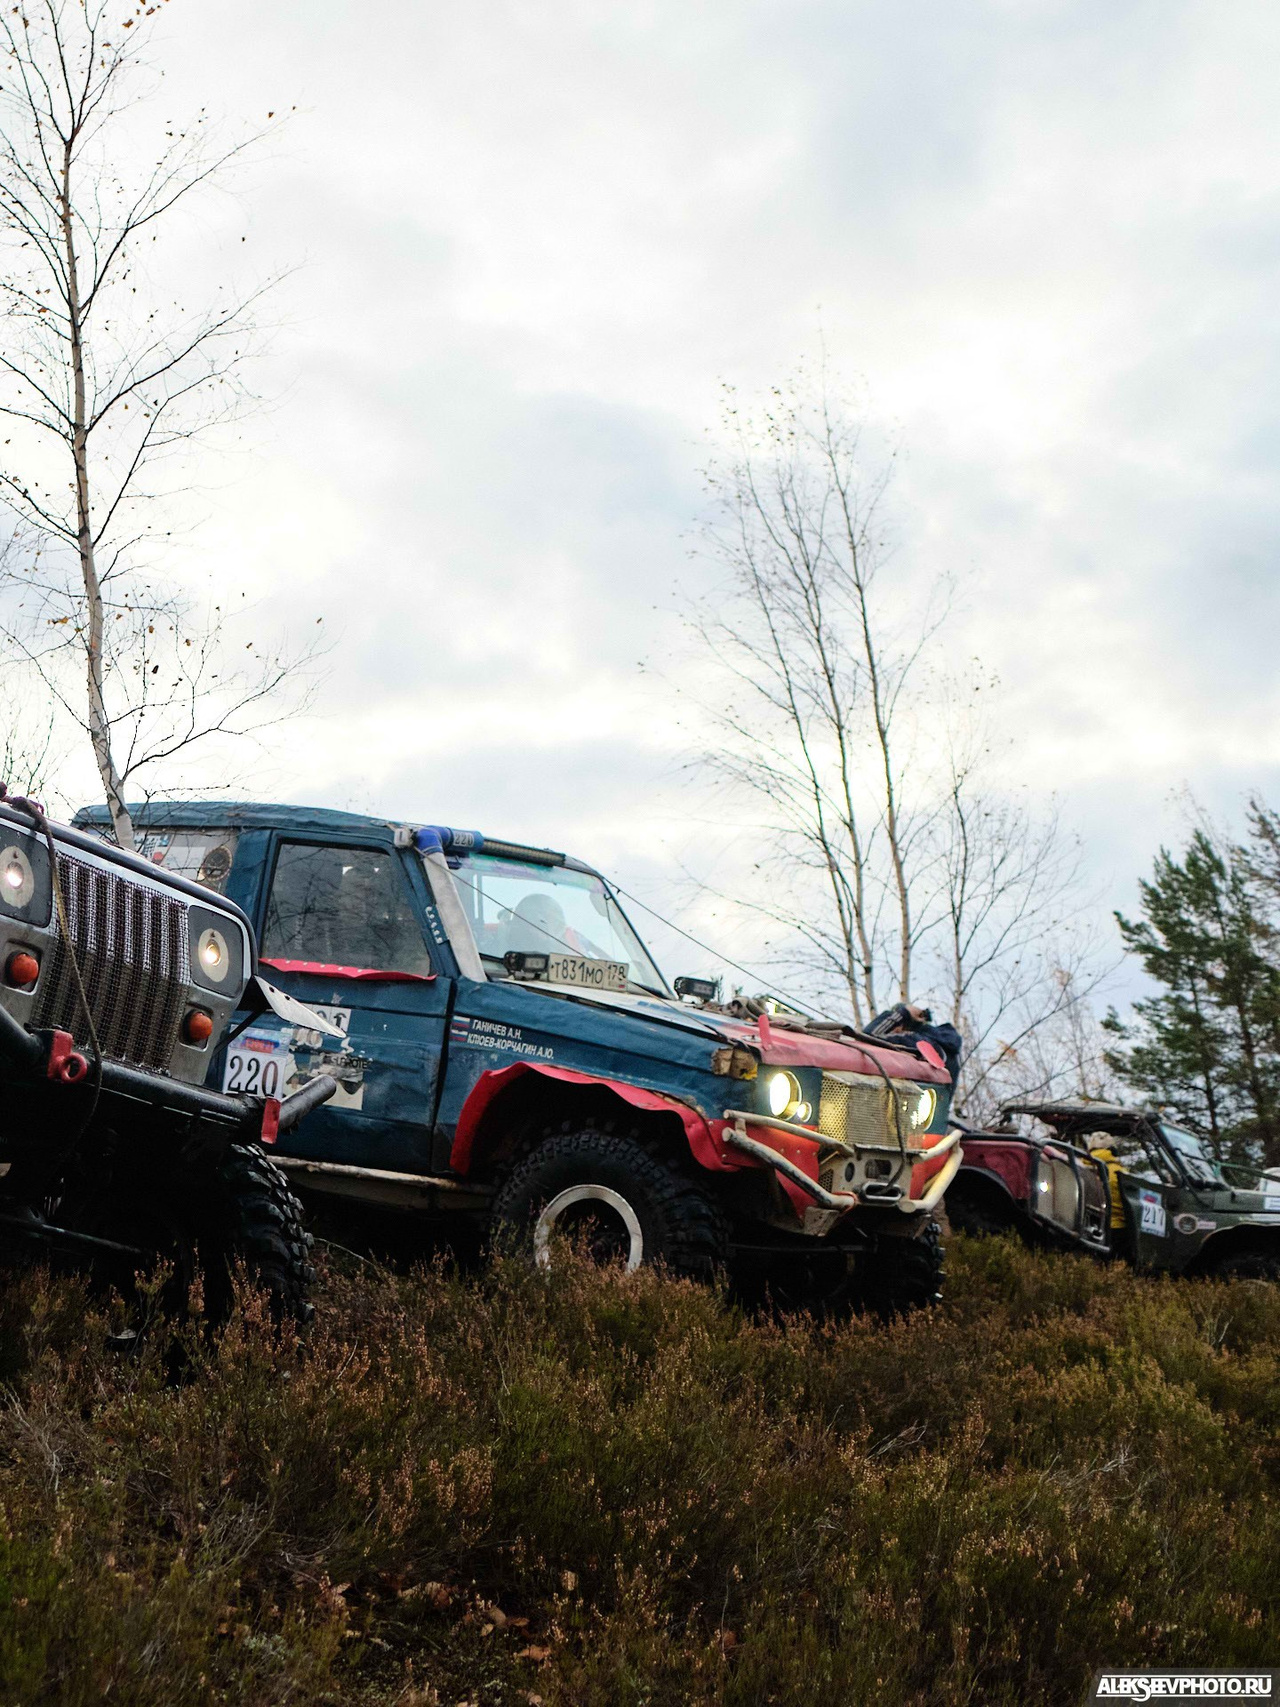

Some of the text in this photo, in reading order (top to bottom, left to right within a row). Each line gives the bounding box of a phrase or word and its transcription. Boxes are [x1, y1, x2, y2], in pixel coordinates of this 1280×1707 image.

[455, 832, 473, 846] 220
[472, 1019, 522, 1040] ГАНИЧЕВ А.Н.
[227, 1055, 279, 1098] 220
[1142, 1205, 1166, 1227] 217
